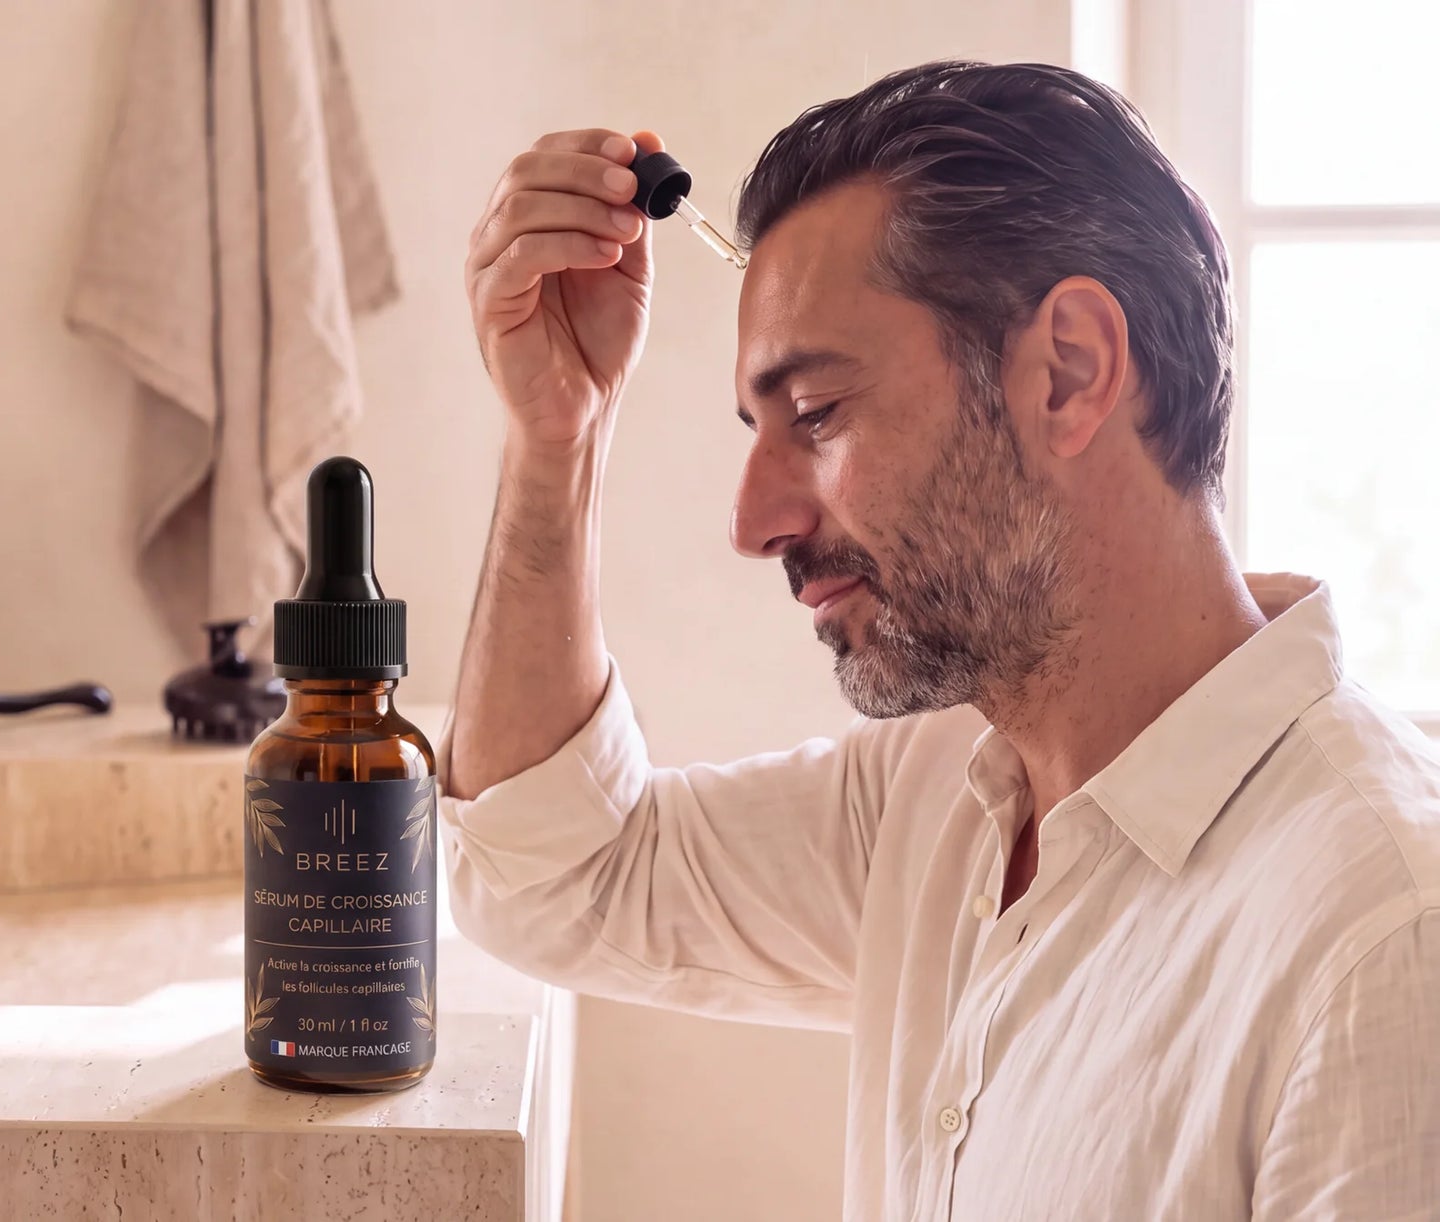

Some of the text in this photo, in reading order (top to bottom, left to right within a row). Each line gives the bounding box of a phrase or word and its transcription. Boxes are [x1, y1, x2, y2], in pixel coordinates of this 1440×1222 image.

[296, 854, 389, 871] BREEZ
[305, 896, 326, 909] DE
[331, 890, 428, 910] CROISSANCE
[288, 918, 392, 933] CAPILLAIRE
[268, 958, 298, 971] Active
[300, 960, 309, 972] la
[313, 961, 372, 973] croissance
[375, 961, 385, 971] et
[282, 981, 406, 996] les follicules capillaires
[298, 1018, 314, 1031] 30
[318, 1018, 335, 1031] ml
[350, 1019, 355, 1031] 1
[360, 1018, 370, 1031] fl
[373, 1021, 388, 1031] oz
[298, 1044, 348, 1058] MARQUE
